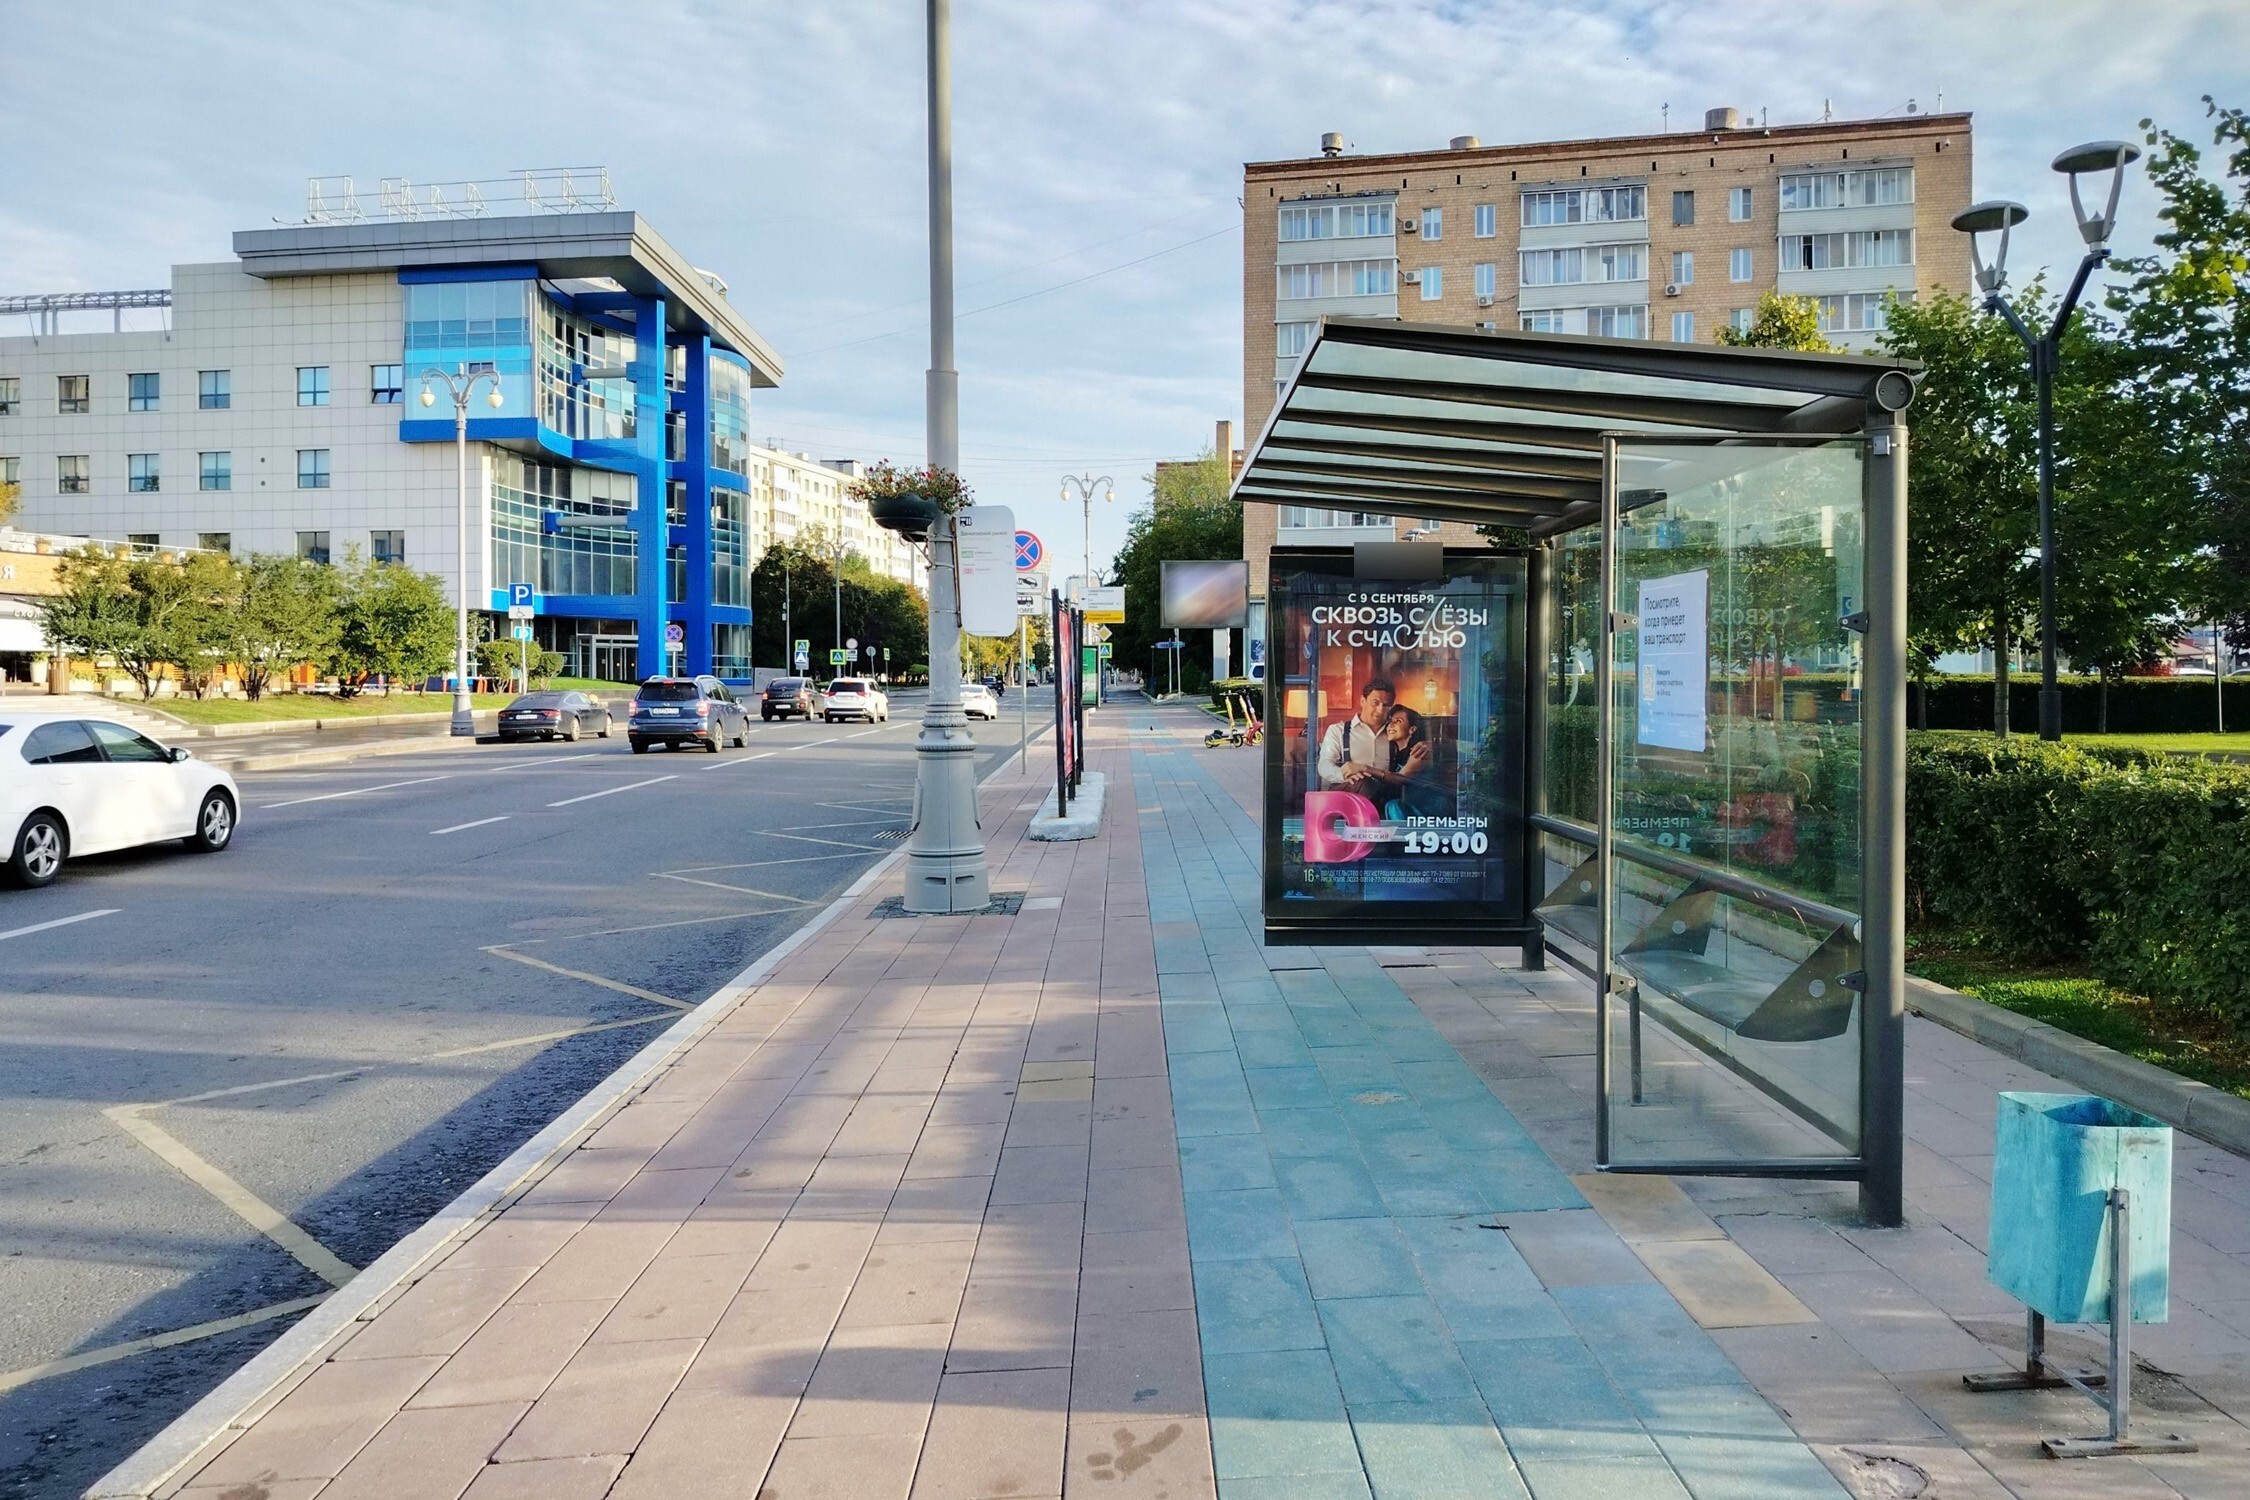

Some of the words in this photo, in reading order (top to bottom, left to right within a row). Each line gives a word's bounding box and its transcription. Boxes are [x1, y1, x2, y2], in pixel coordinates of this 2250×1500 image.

[515, 585, 530, 605] P
[1347, 593, 1357, 604] С
[1360, 593, 1367, 604] 9
[1371, 593, 1435, 604] СЕНТЯБРЯ
[1311, 606, 1403, 625] СКВОЗЬ
[1409, 599, 1488, 632] СЛЁЗЫ
[1644, 617, 1660, 630] когда
[1661, 615, 1685, 629] приедет
[1327, 629, 1342, 647] К
[1348, 624, 1467, 650] СЧАСТЬЮ
[1644, 635, 1655, 646] ваш
[1656, 633, 1686, 647] транспорт
[1406, 816, 1488, 828] ПРЕМЬЕРЫ
[1403, 831, 1488, 854] 19:00
[1303, 868, 1320, 883] 16+
